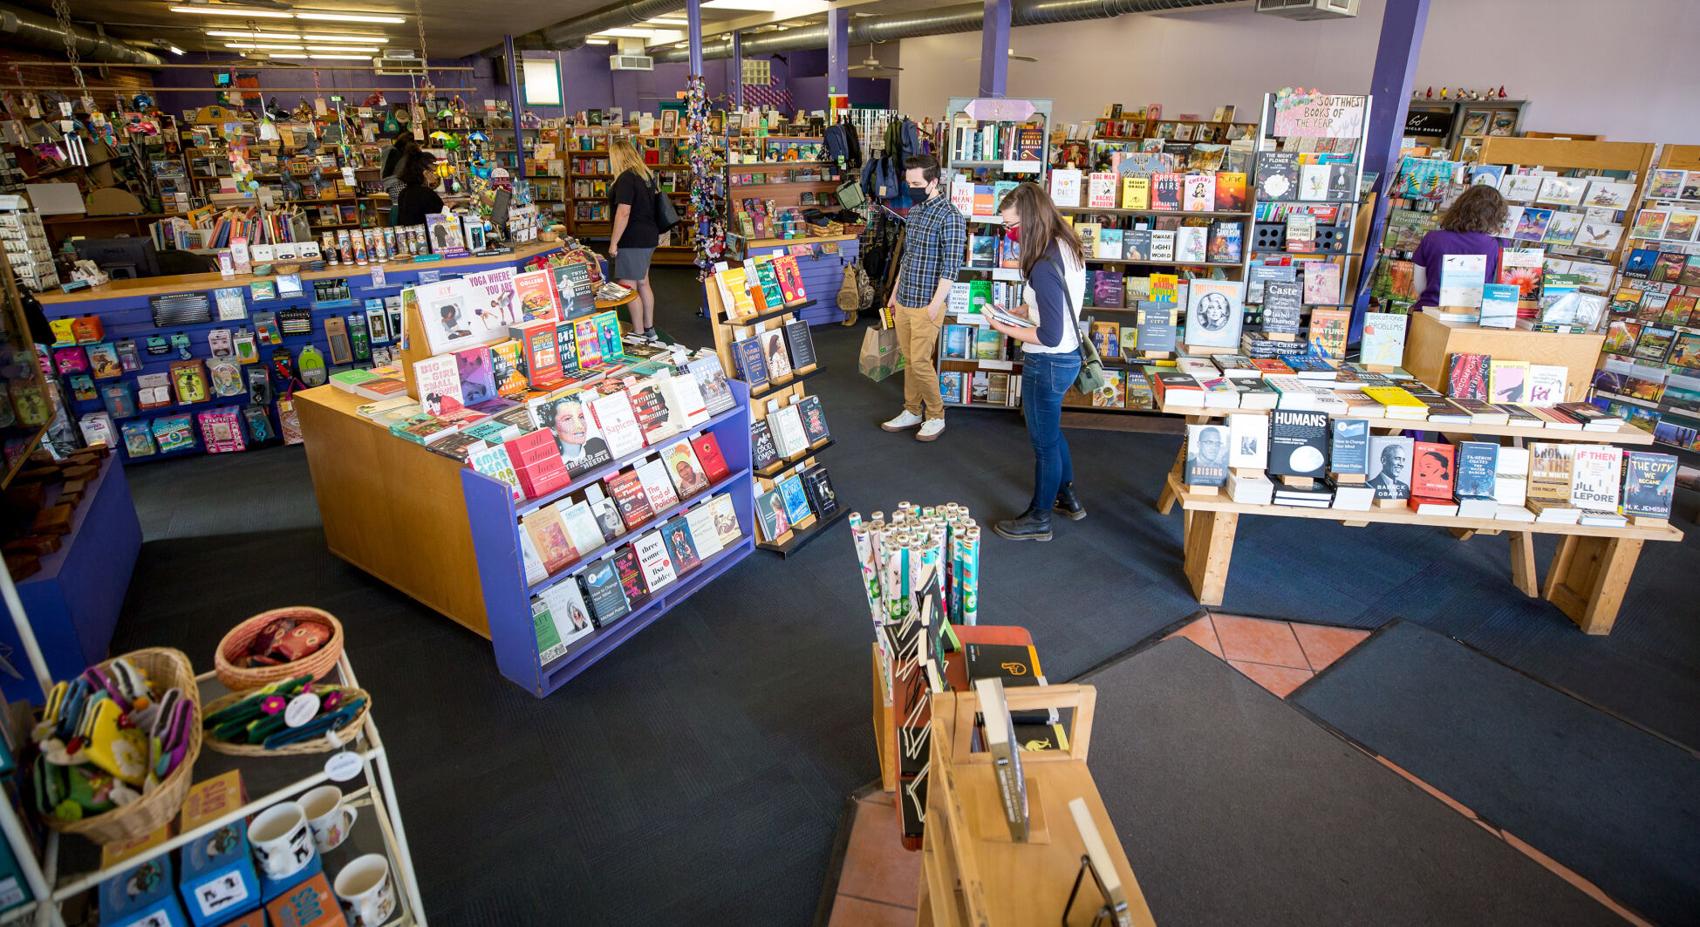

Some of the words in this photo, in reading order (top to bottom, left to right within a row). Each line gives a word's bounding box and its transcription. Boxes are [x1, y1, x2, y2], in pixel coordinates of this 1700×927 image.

[1317, 96, 1365, 107] SOUTHWEST
[1304, 107, 1330, 118] BOOKS
[1333, 109, 1345, 118] OF
[1295, 118, 1309, 127] THE
[1313, 119, 1334, 128] YEAR
[1154, 182, 1178, 190] HAIRS
[469, 275, 488, 287] YOGA
[488, 271, 511, 284] WHERE
[486, 285, 500, 295] YOU
[501, 282, 513, 293] ARE
[1270, 285, 1297, 296] Caste
[557, 329, 574, 342] ONG
[421, 363, 439, 374] BIG
[432, 368, 456, 380] GIRL
[424, 379, 452, 391] SMALL
[1274, 411, 1327, 427] HUMANS
[606, 418, 636, 433] Sapiens
[530, 433, 543, 446] all
[1577, 450, 1588, 461] IF
[1590, 451, 1617, 462] THEN
[1191, 466, 1223, 476] ARISING
[1632, 461, 1649, 471] THE
[1650, 462, 1673, 473] CITY
[647, 486, 660, 496] The
[1574, 481, 1595, 492] JILL
[651, 491, 664, 502] End
[664, 488, 671, 497] of
[1573, 491, 1614, 503] LEPORE
[654, 495, 679, 511] Policing
[1641, 505, 1668, 513] JEMISIN
[642, 542, 658, 554] three
[652, 566, 665, 576] lisa
